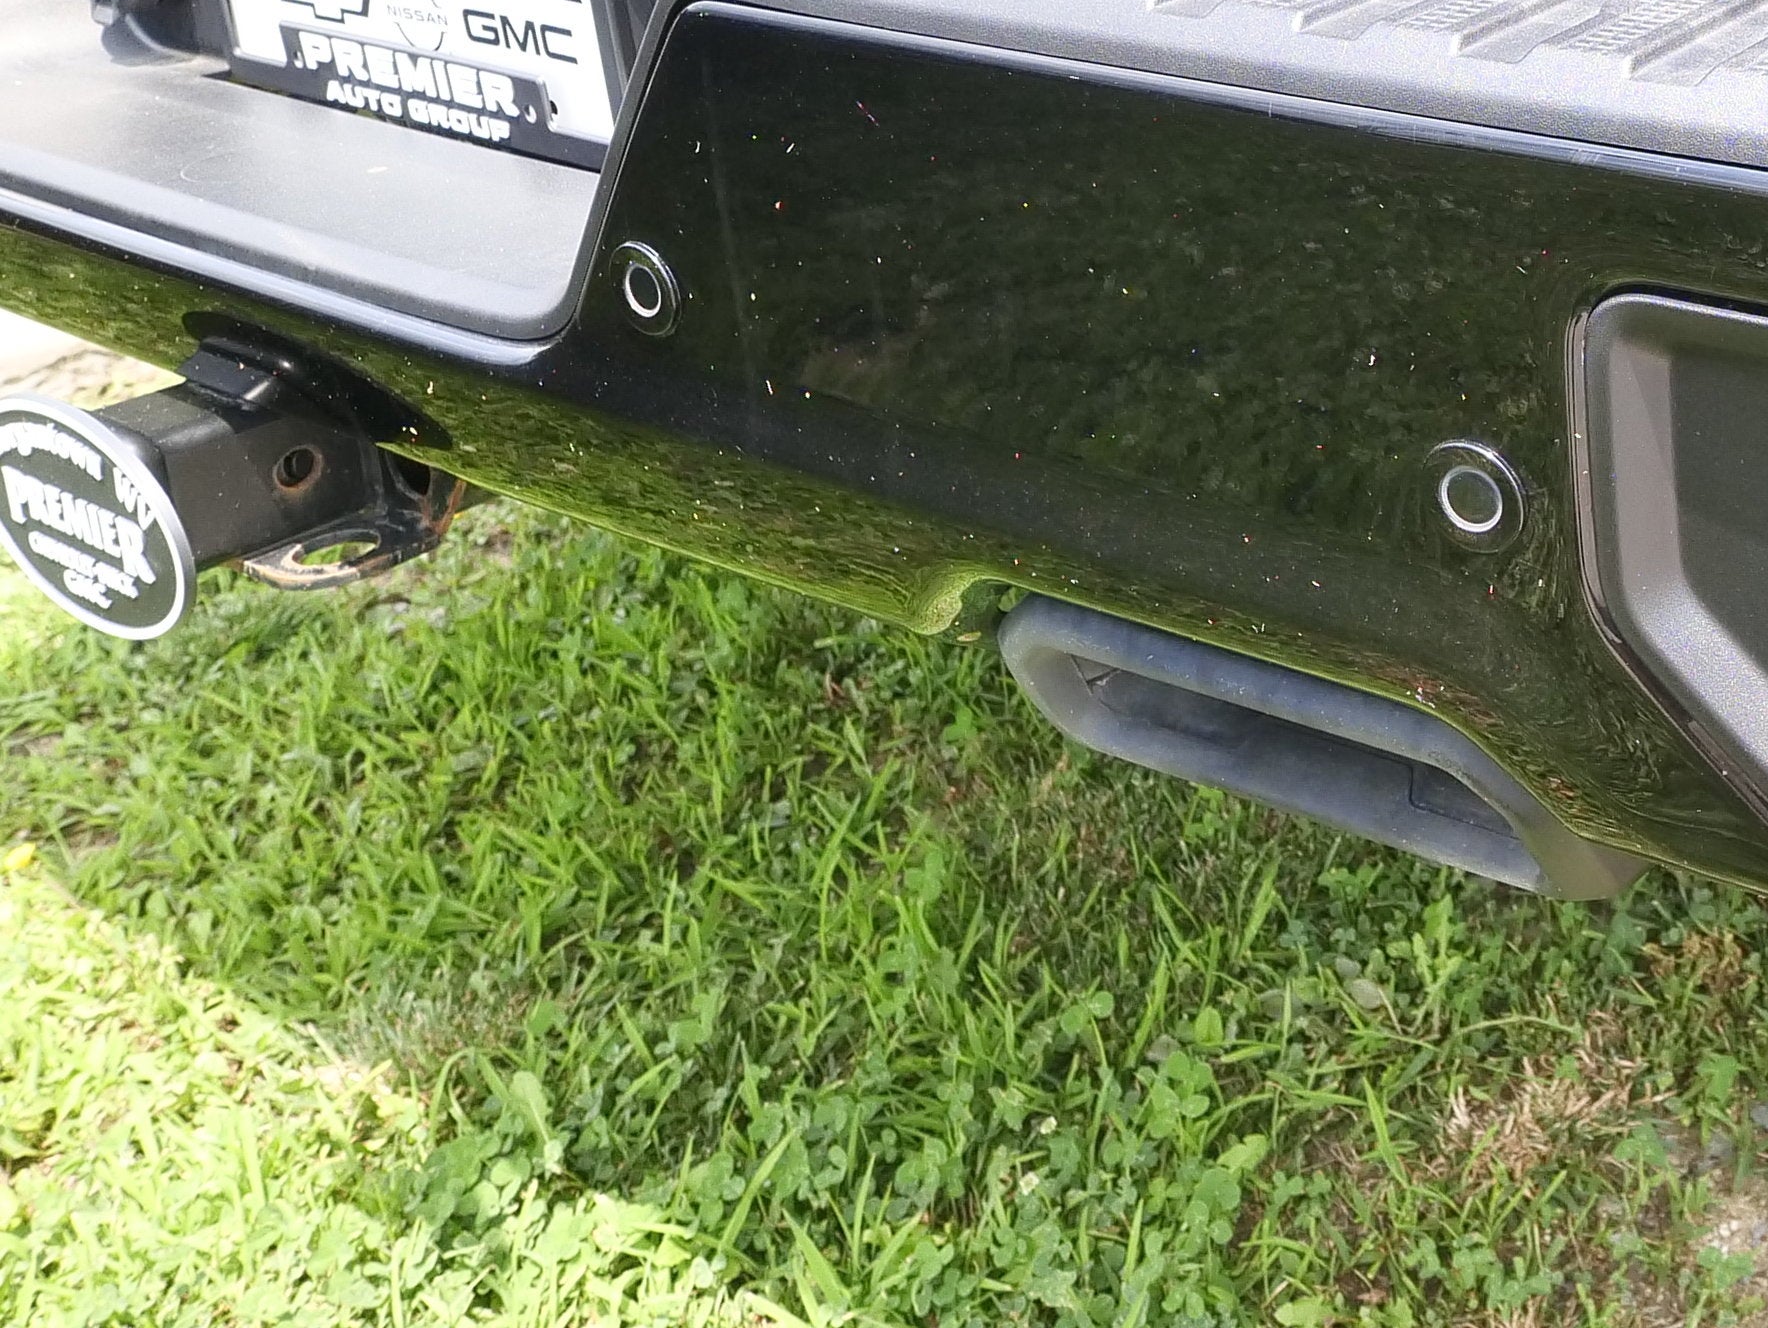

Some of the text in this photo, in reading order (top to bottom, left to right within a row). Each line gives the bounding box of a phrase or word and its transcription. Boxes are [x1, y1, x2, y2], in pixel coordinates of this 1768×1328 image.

[386, 3, 578, 65] NISSAN GMC
[298, 32, 520, 119] PREMIER
[326, 79, 511, 143] AUTO GROUP
[1, 465, 156, 585] PREMIER
